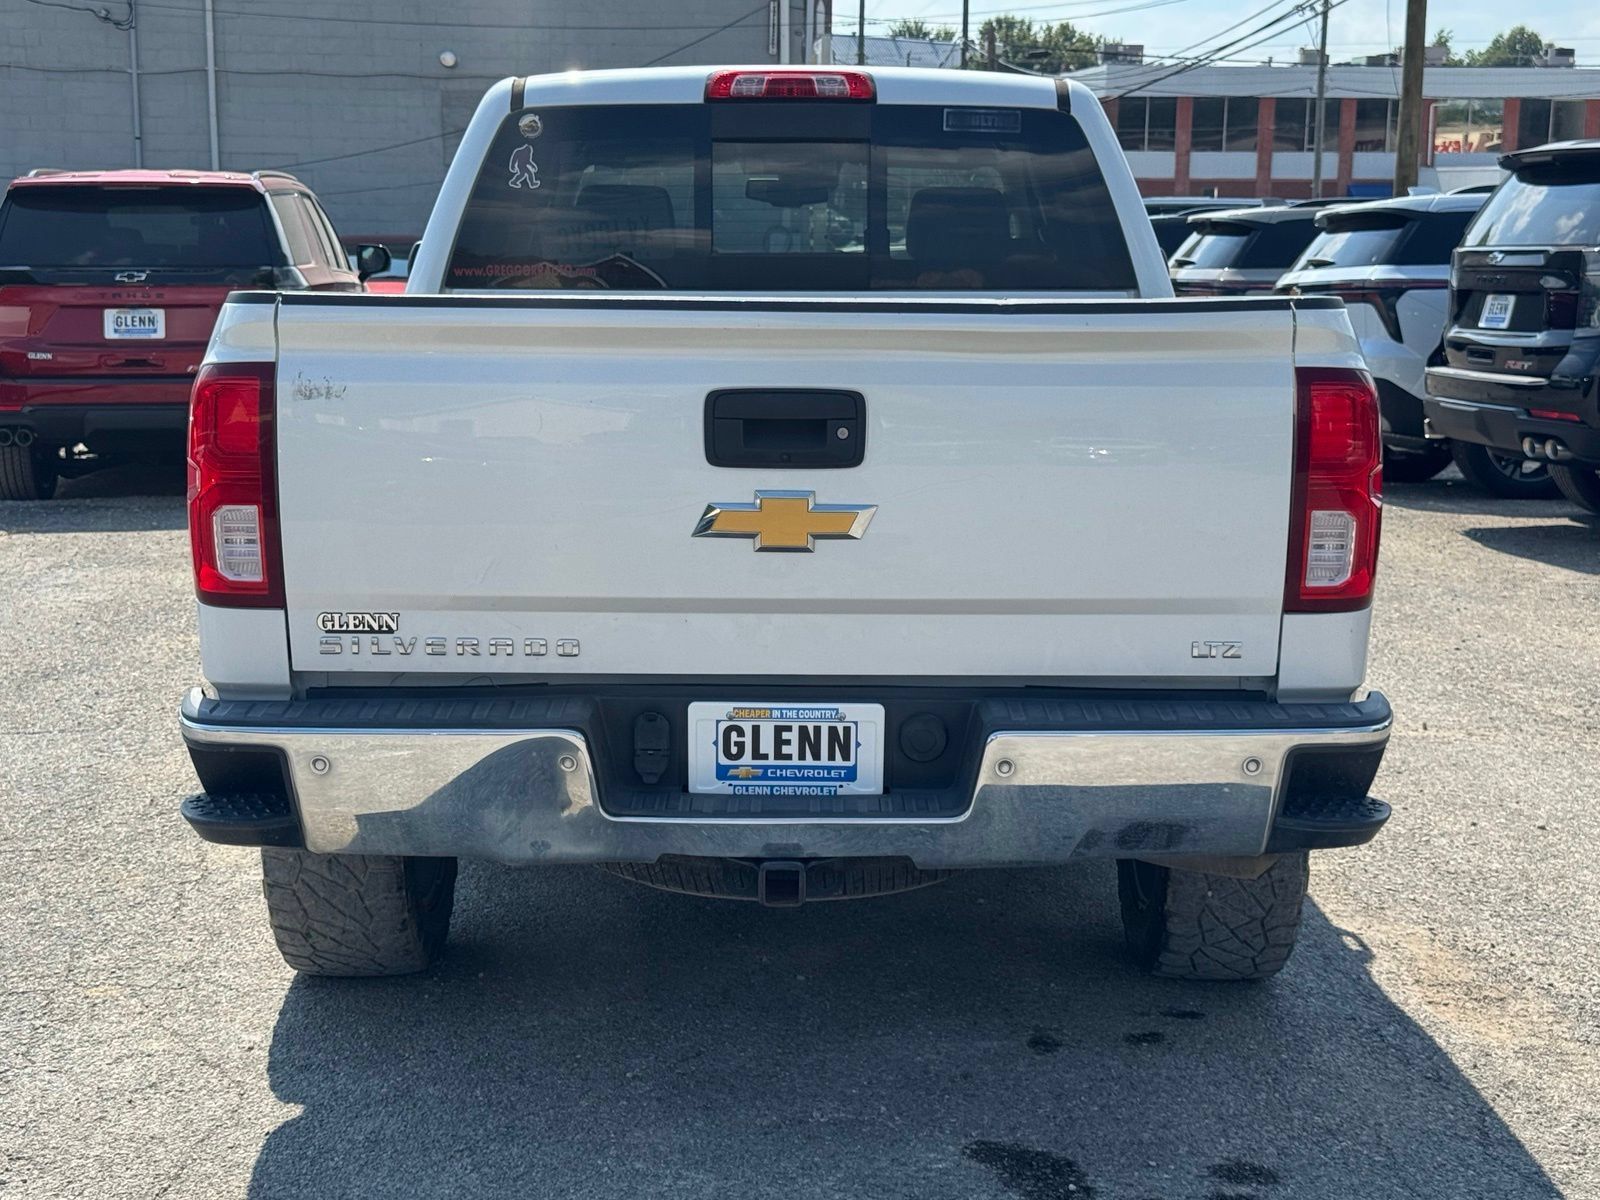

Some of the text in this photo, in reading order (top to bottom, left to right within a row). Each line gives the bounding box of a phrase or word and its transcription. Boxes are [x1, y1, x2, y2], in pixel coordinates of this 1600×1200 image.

[115, 315, 155, 327] GLENN
[27, 352, 53, 361] GLENN
[317, 612, 400, 632] GLENN
[319, 636, 580, 656] SILVERADO
[1191, 641, 1242, 658] LTZ
[732, 708, 839, 719] CHEAPER IN THE COUNTRY.
[722, 725, 852, 762] GLENN
[767, 768, 847, 778] CHEVROLET
[735, 785, 836, 796] GLENN CHEVROLET
